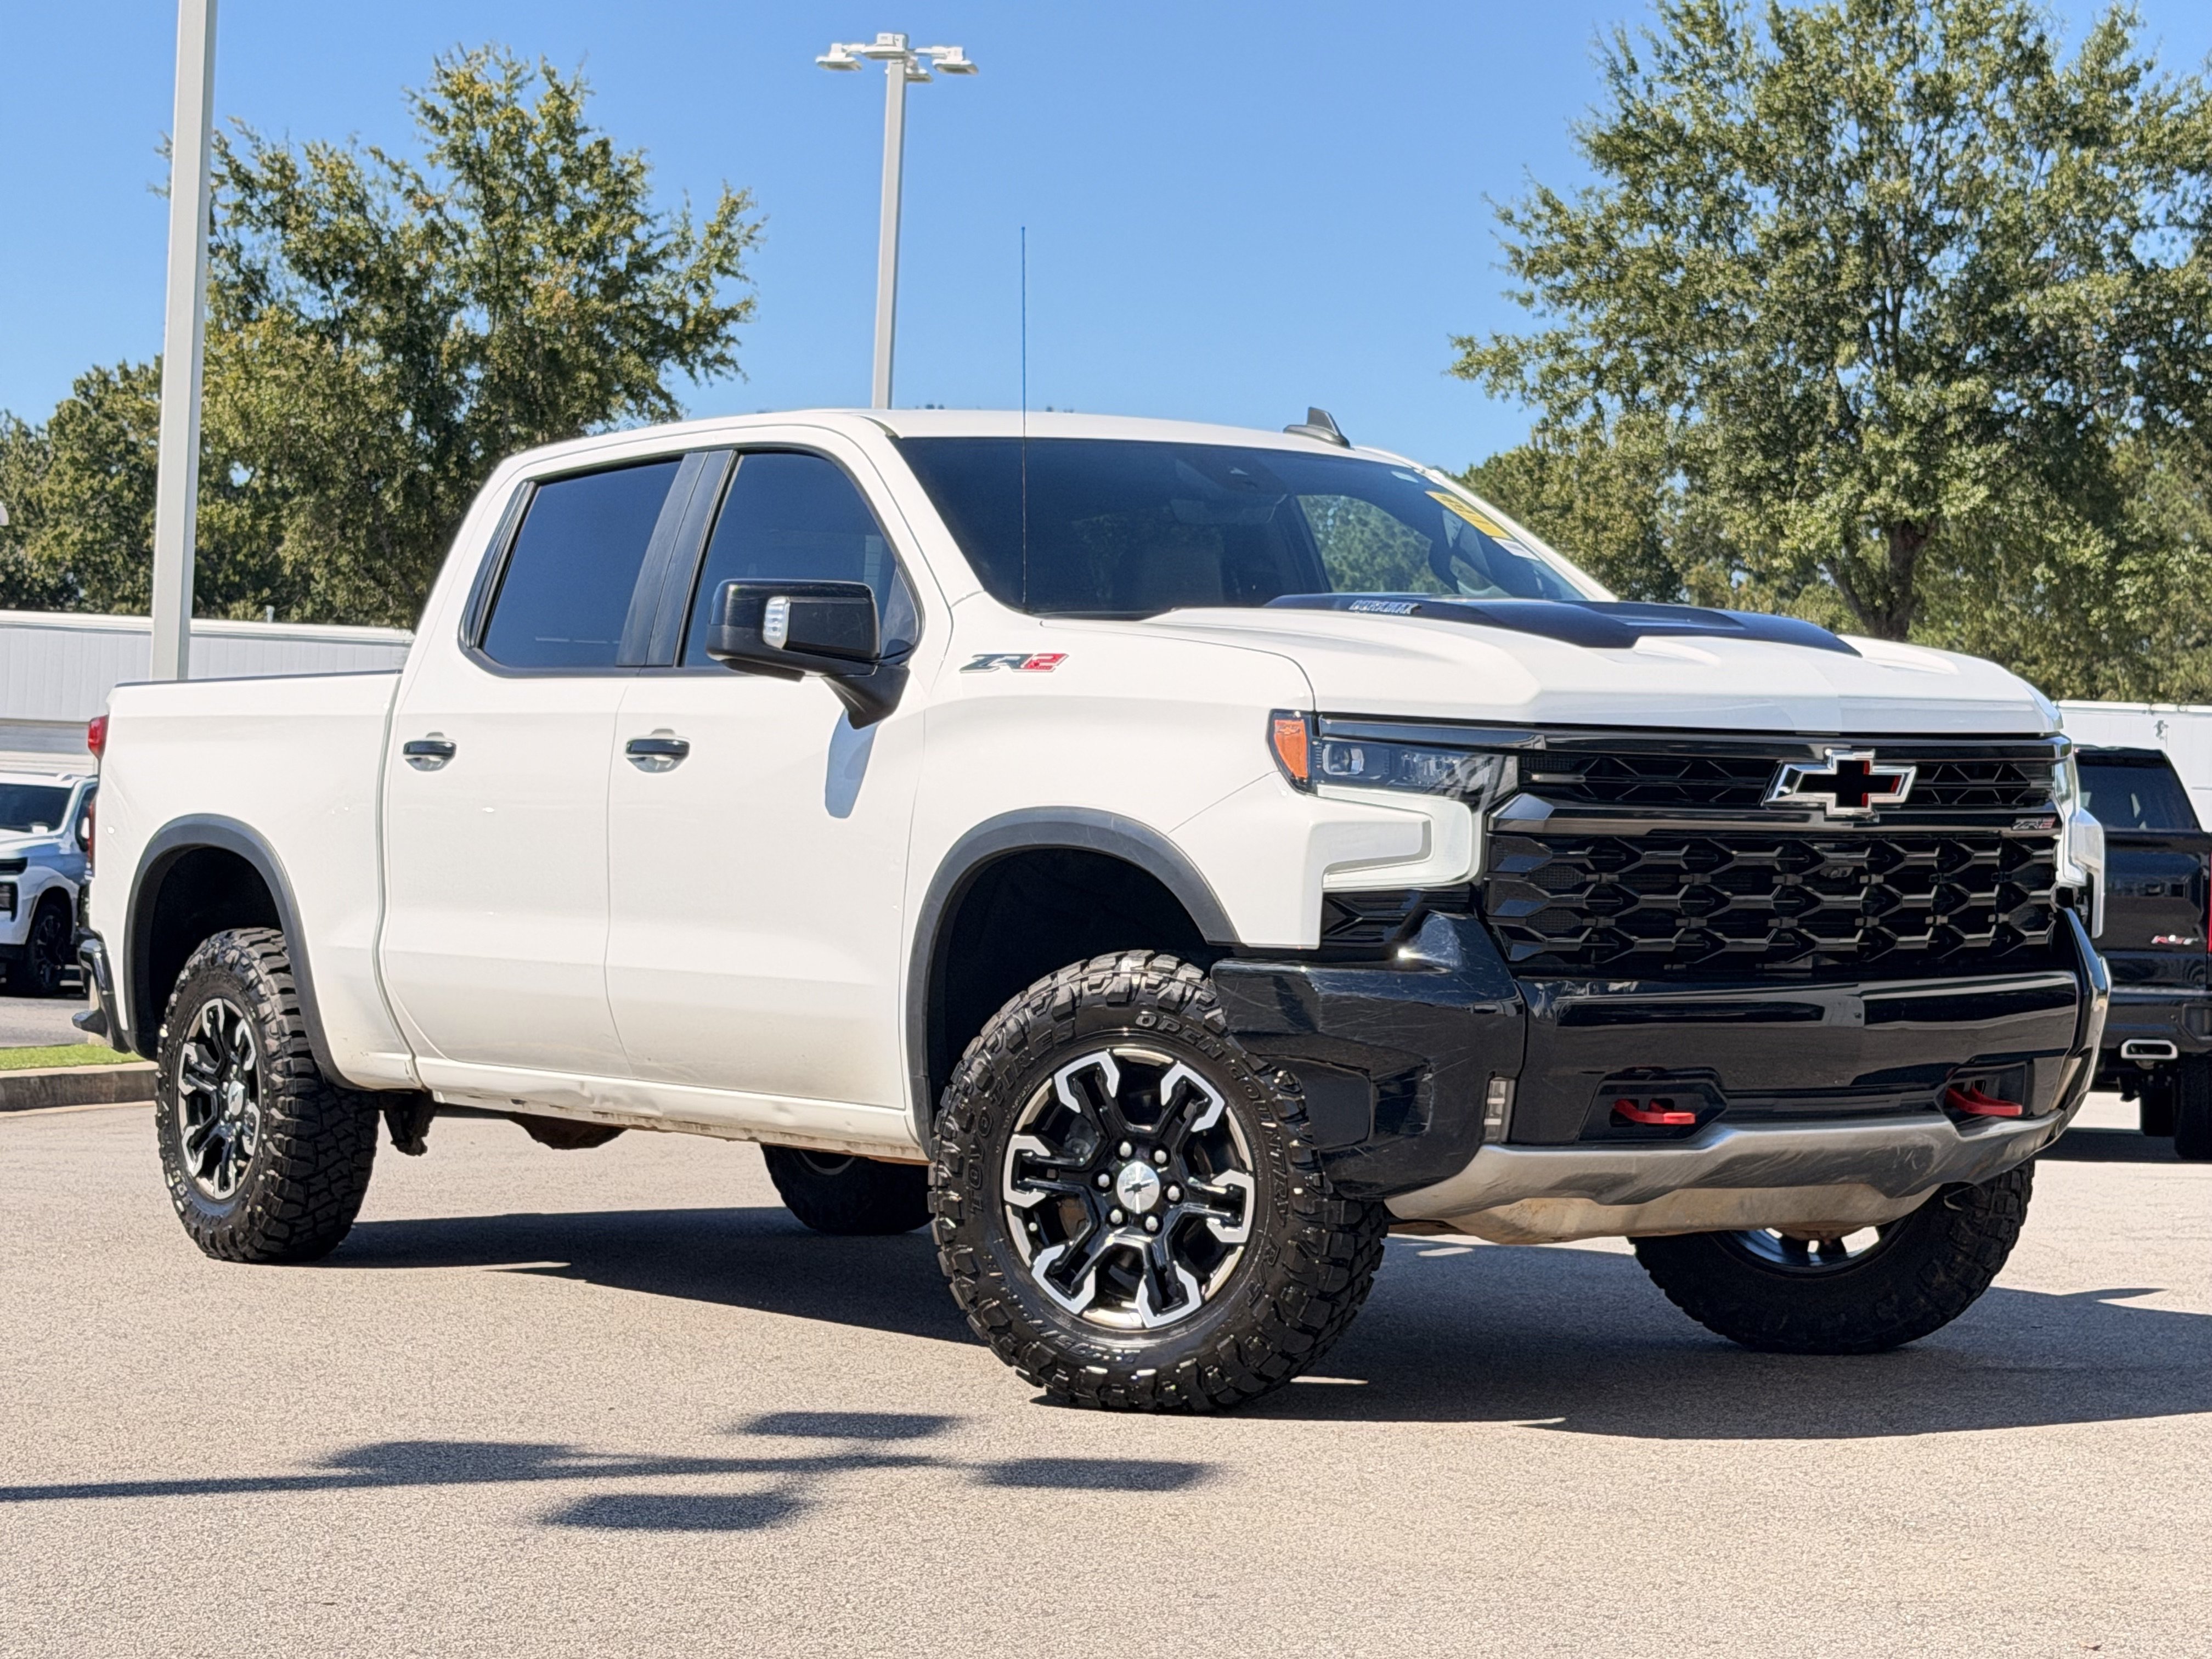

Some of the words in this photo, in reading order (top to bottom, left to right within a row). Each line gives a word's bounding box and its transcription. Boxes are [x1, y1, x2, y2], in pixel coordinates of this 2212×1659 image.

[1348, 599, 1419, 615] DURAMAX
[959, 653, 1069, 673] ZR2
[2012, 816, 2057, 830] ZR2
[1135, 1011, 1225, 1061] OPEN
[968, 1108, 992, 1214] TOYO
[986, 1017, 1076, 1106] TIRES
